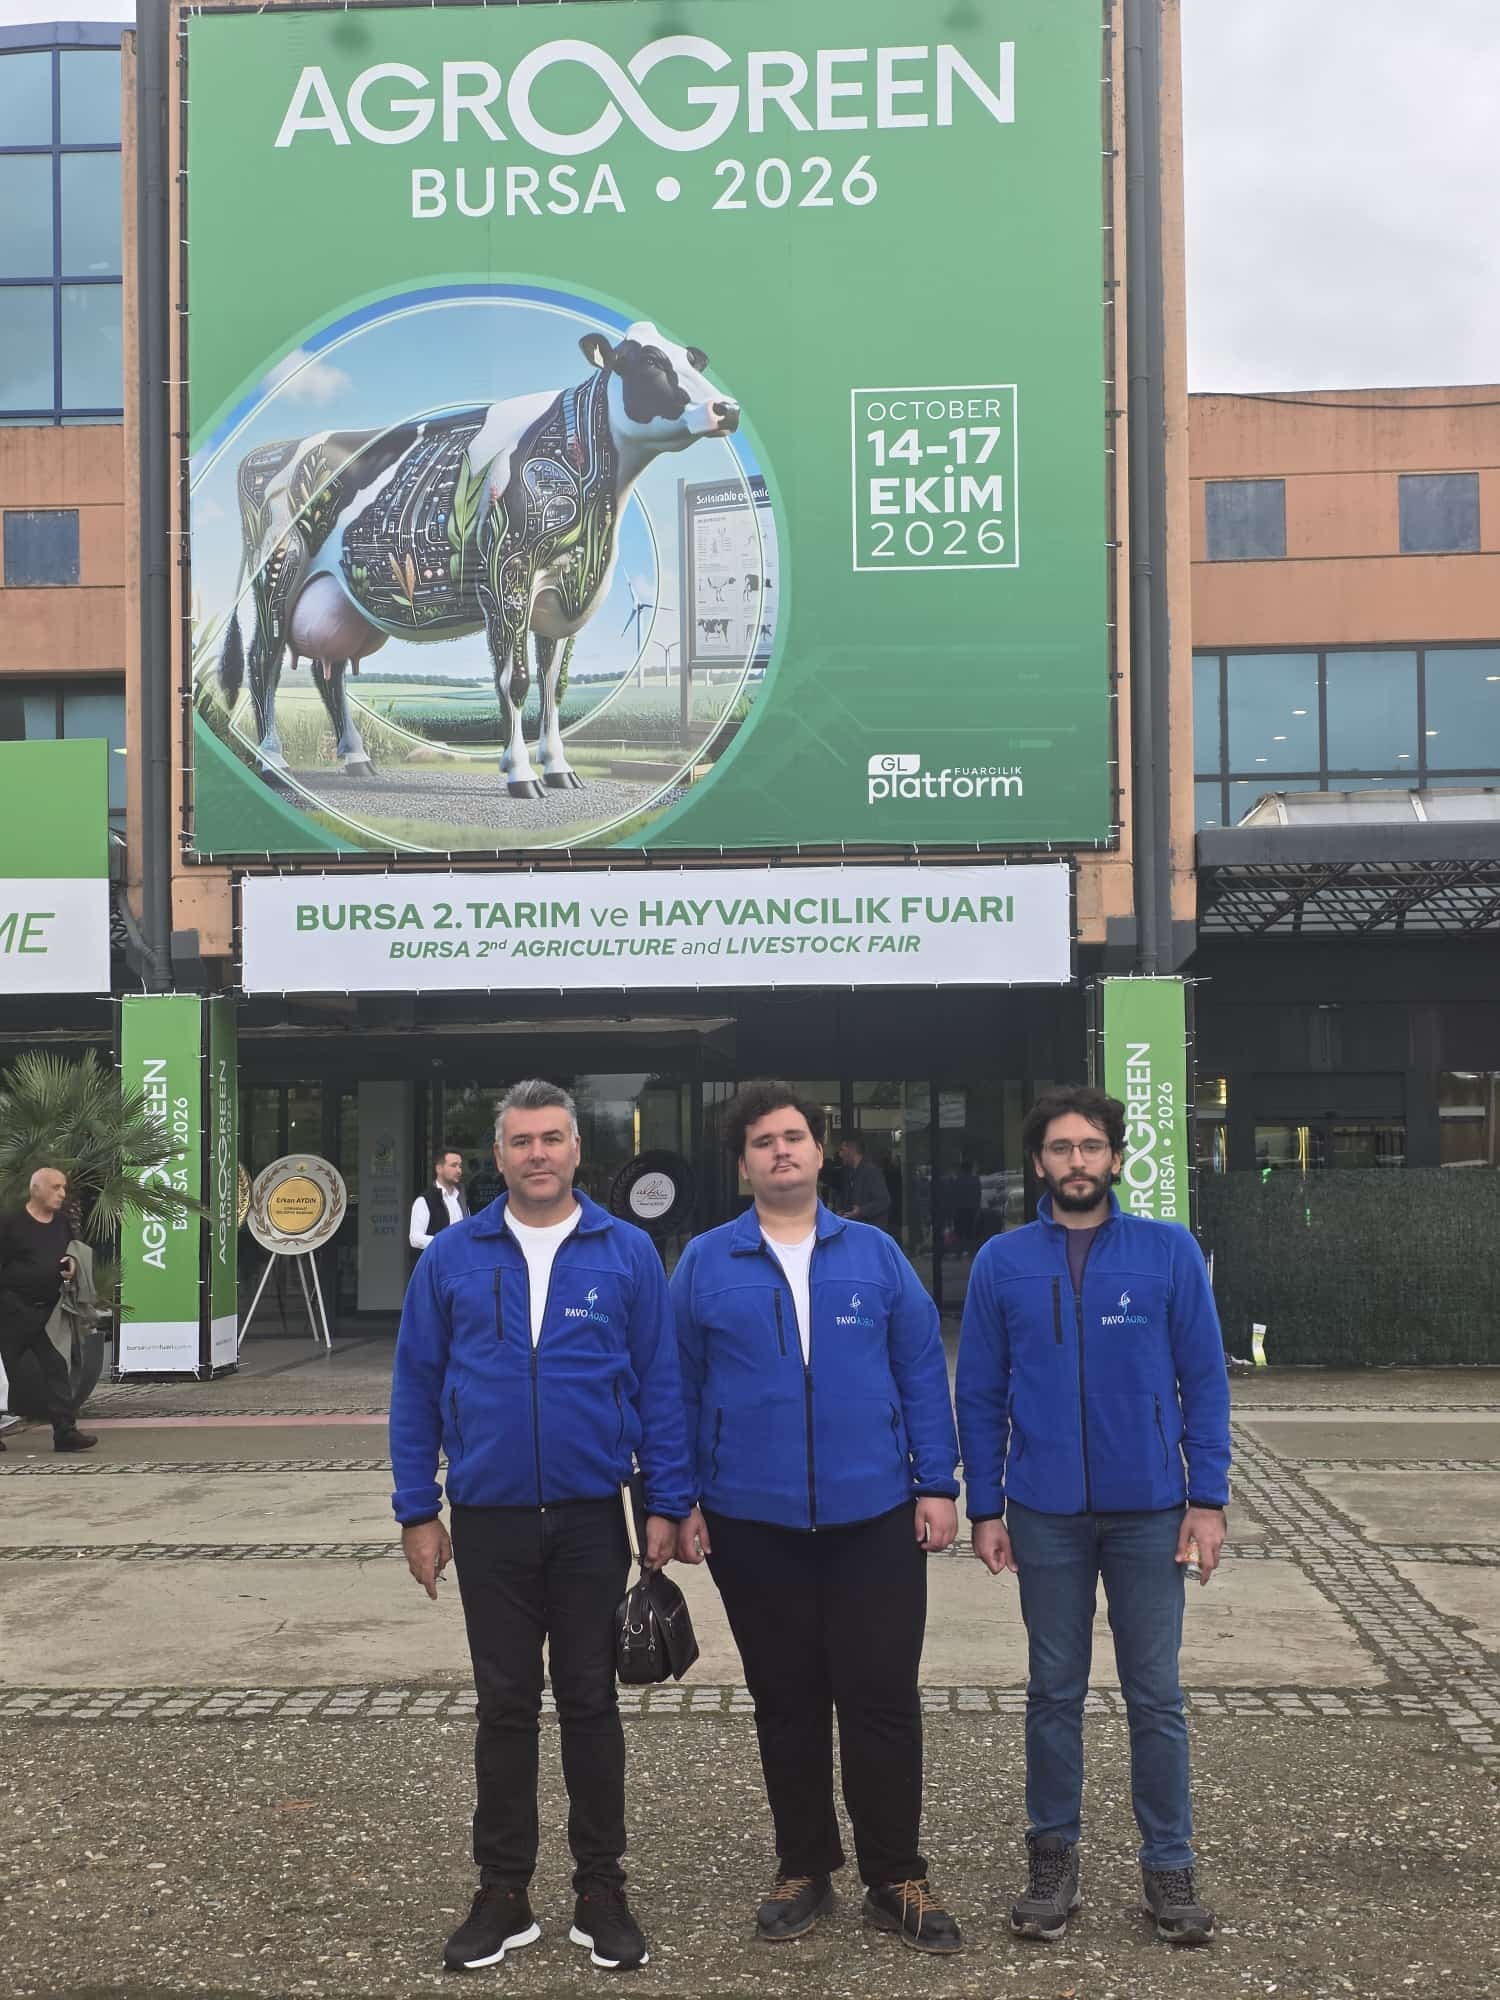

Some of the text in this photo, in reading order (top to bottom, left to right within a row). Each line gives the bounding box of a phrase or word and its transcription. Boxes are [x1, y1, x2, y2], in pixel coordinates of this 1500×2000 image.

[274, 36, 1016, 157] AGROGREEN
[410, 155, 879, 219] BURSA 2026
[867, 399, 1001, 421] OCTOBER
[867, 426, 1001, 466] 14-17
[870, 464, 1003, 515] EKİM
[871, 519, 1005, 556] 2026
[881, 757, 907, 771] GL
[954, 766, 1023, 776] FUARCILIK
[868, 768, 1024, 805] platform
[296, 903, 425, 931] BURSA
[590, 906, 629, 927] ve
[639, 896, 892, 927] HAYVANCILIK
[900, 895, 1014, 923] FUARI
[389, 940, 471, 960] BURSA
[510, 938, 678, 958] AGRICULTURE
[681, 936, 722, 956] and
[725, 934, 864, 955] LIVESTOCK
[866, 934, 922, 954] FAIR
[173, 1097, 188, 1144] 2026
[1157, 1081, 1176, 1218] BURSA 2026
